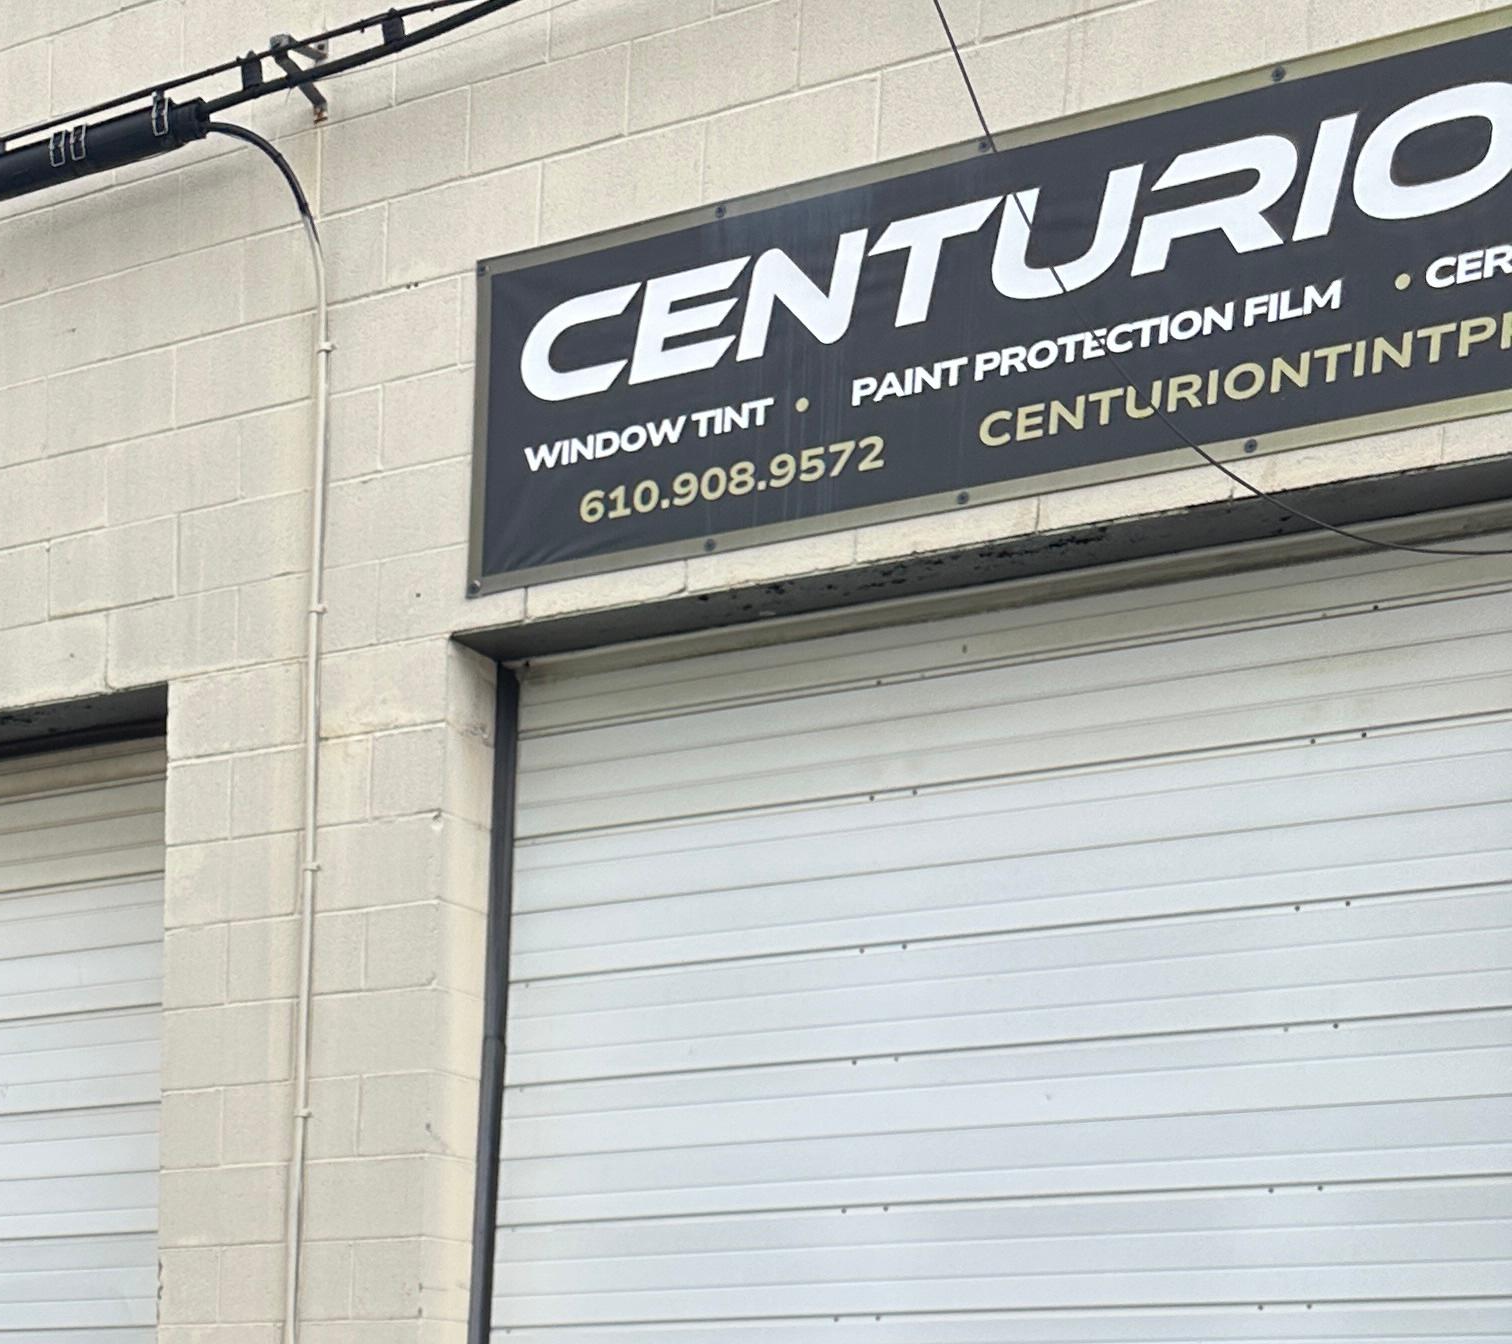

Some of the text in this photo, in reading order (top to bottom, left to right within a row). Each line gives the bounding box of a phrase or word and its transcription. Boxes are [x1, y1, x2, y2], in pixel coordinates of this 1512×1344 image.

[519, 80, 1512, 402] CENTURIO
[523, 414, 687, 472] WINDOW
[691, 397, 775, 438] TINT
[850, 356, 969, 408] PAINT
[973, 301, 1235, 382] PROTECTION
[1242, 278, 1344, 328] FILM
[578, 434, 886, 524] 610.908.9572
